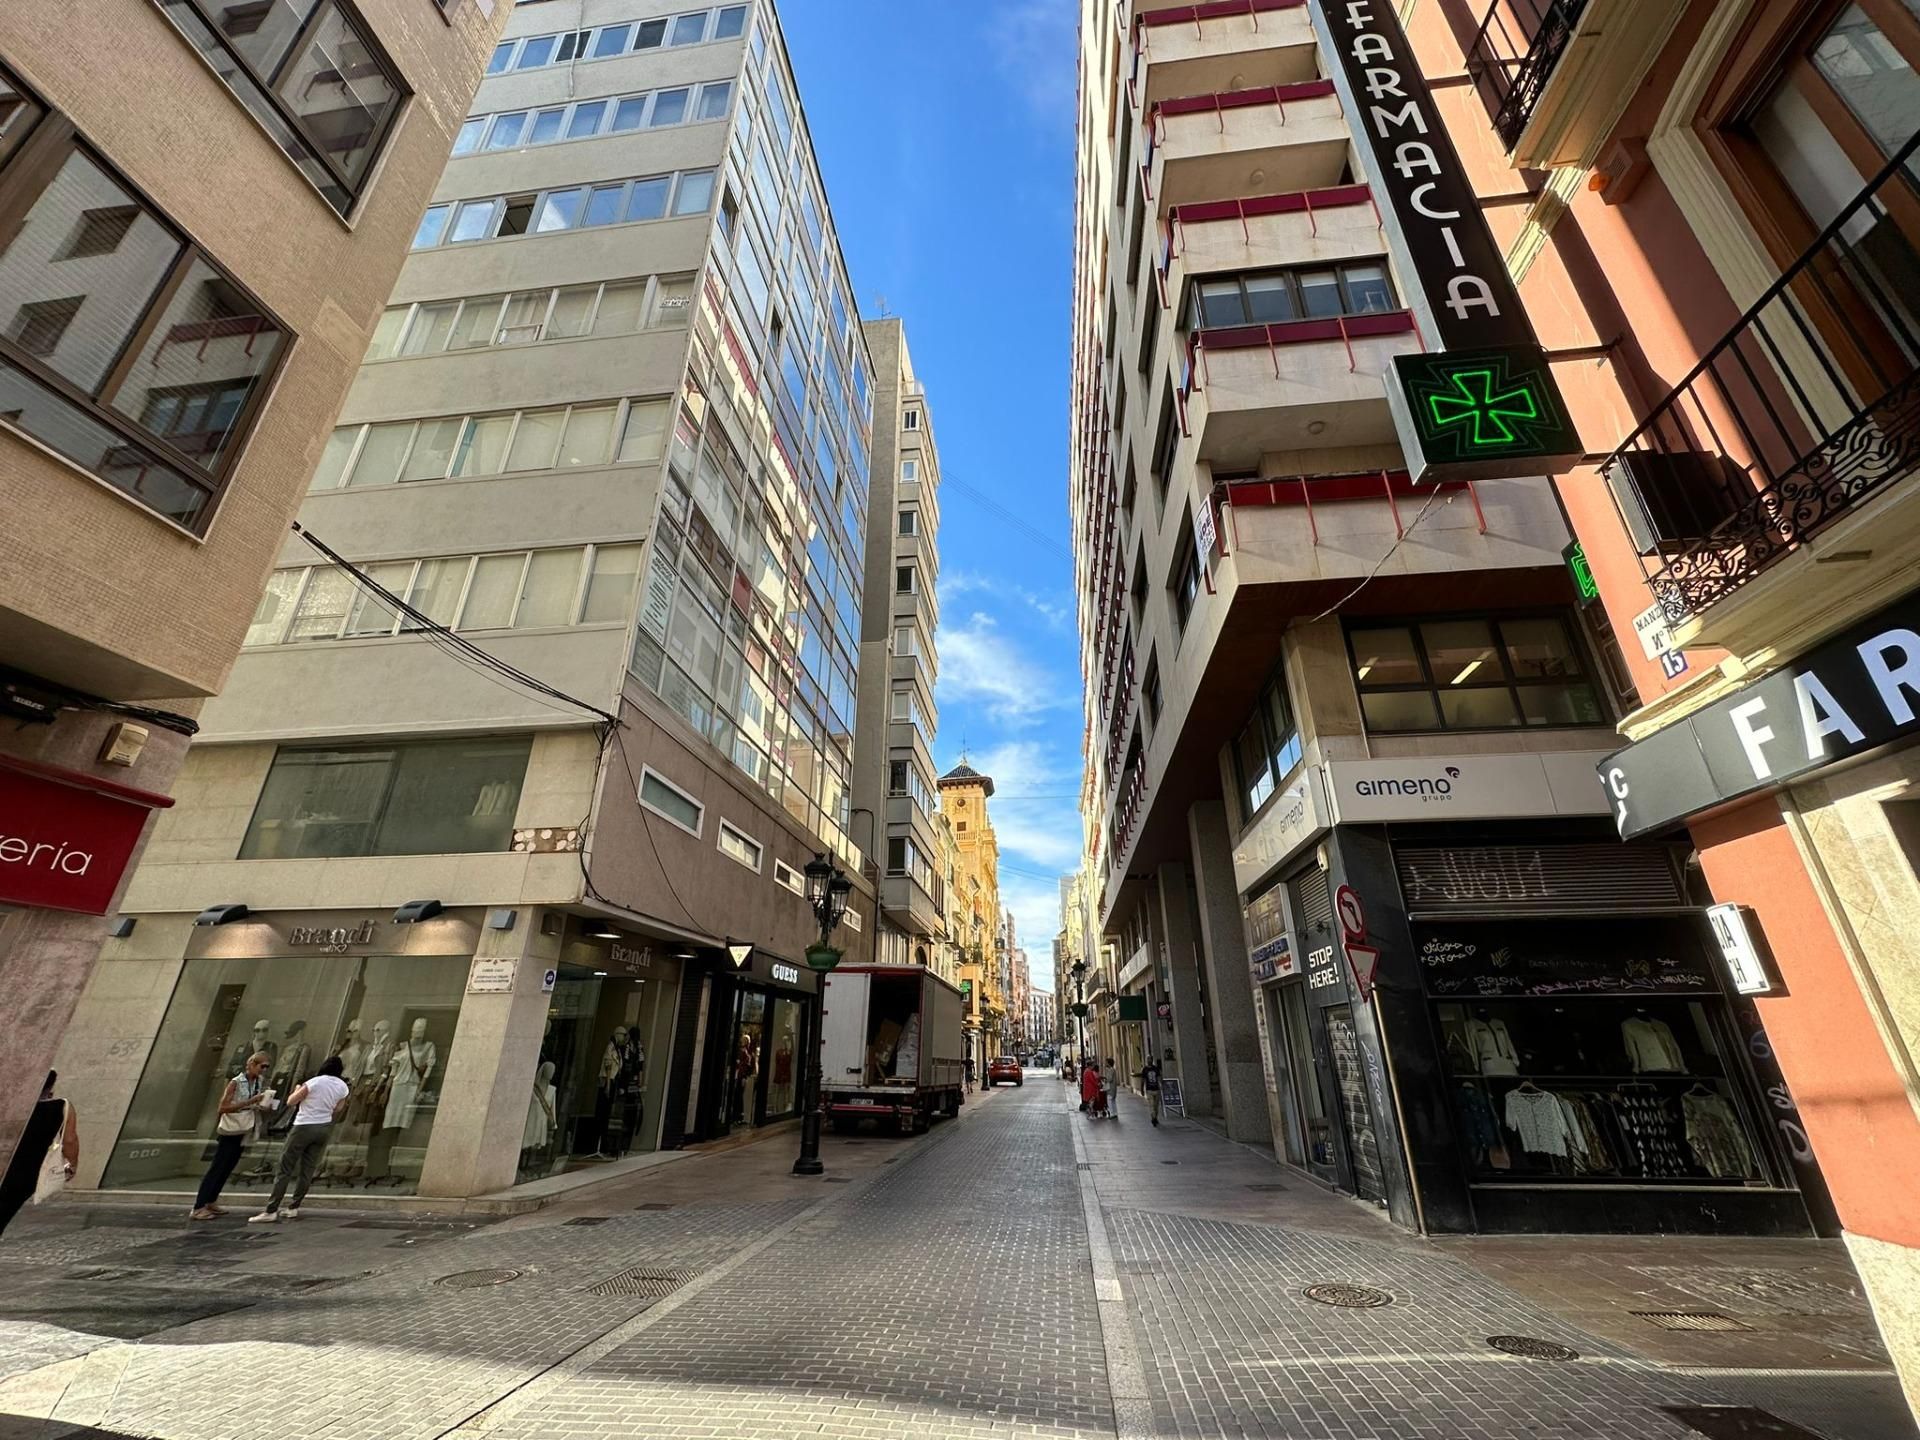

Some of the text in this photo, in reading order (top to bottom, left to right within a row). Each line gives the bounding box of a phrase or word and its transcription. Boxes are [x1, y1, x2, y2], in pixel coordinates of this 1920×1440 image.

[1346, 1, 1500, 320] FARMACIA
[1662, 650, 1684, 678] 15
[1422, 794, 1452, 803] grupo
[0, 834, 93, 876] ería
[289, 919, 376, 944] Brandi
[610, 943, 652, 968] Brandi
[1308, 945, 1333, 968] STOP
[772, 963, 798, 984] GUESS
[1309, 962, 1340, 990] HERE!
